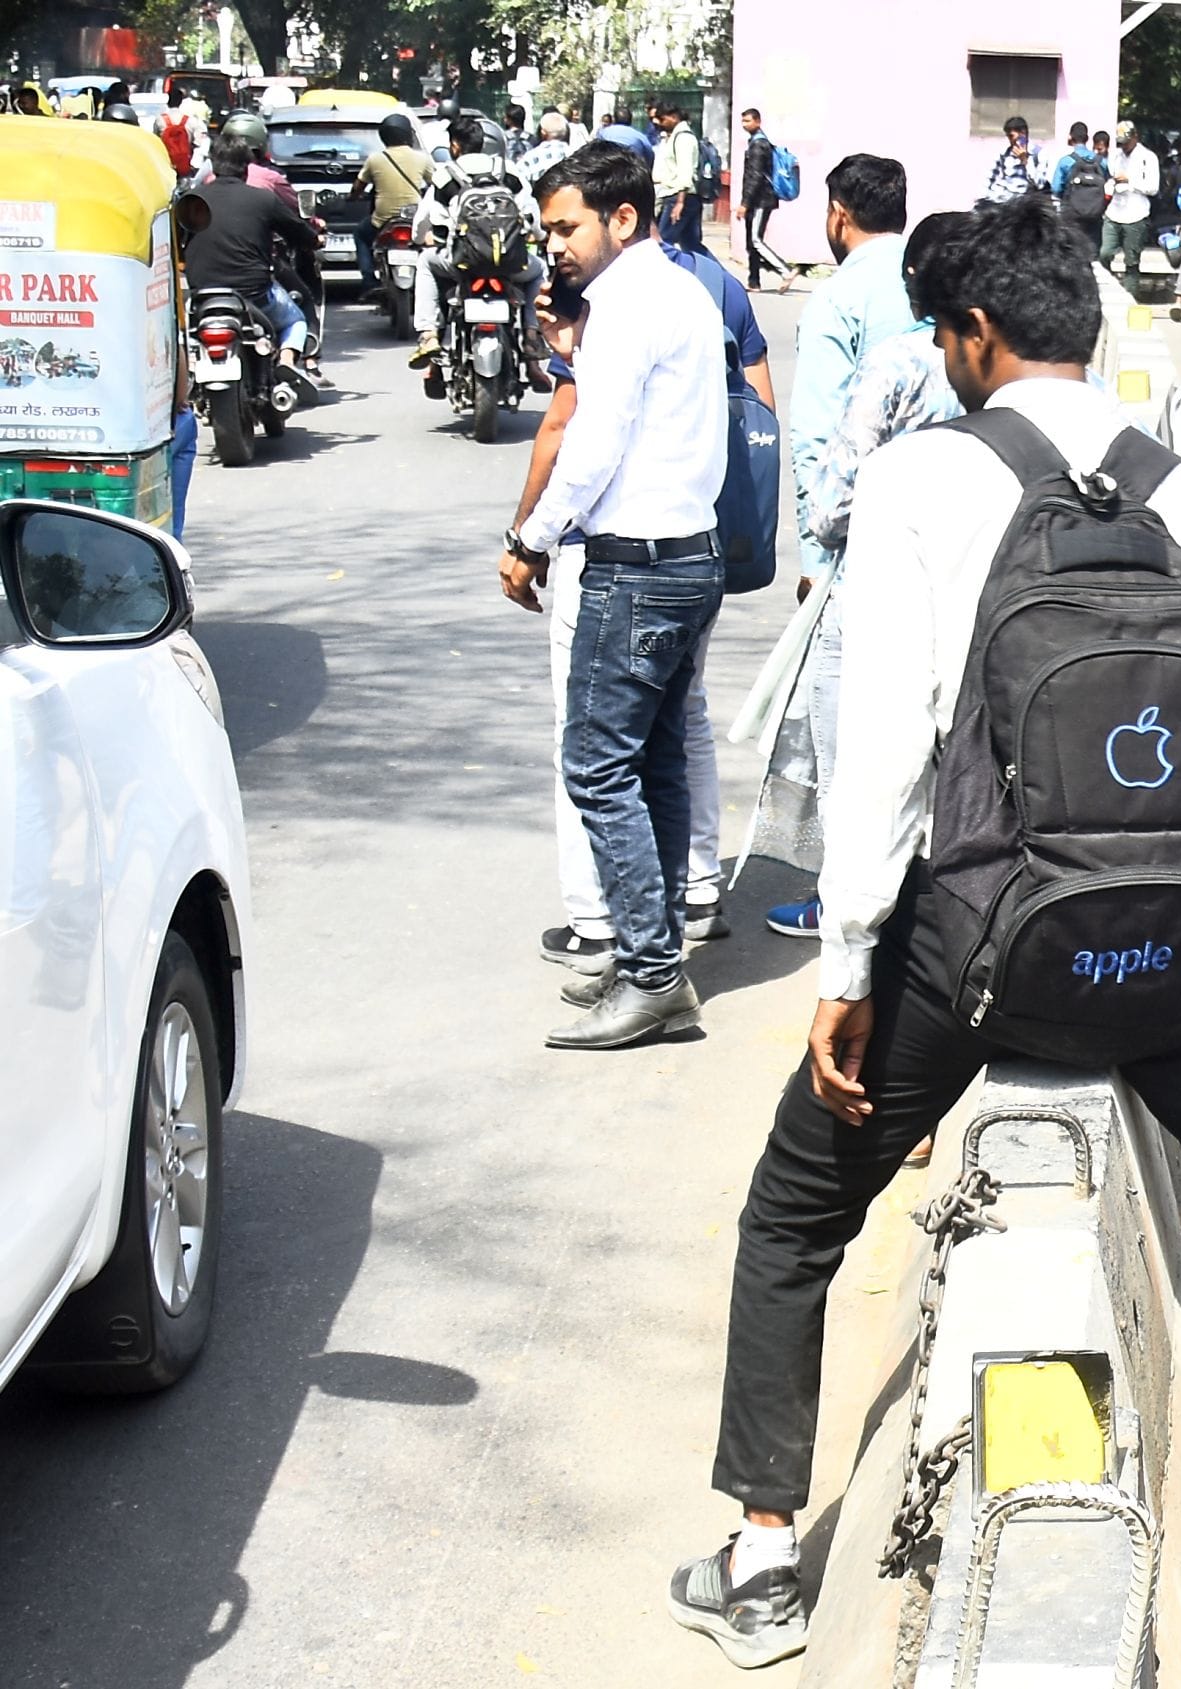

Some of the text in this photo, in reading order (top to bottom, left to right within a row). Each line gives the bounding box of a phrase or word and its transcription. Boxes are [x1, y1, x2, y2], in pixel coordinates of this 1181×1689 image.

[21, 273, 98, 302] PARK
[10, 311, 81, 325] BANQUET HALL
[51, 406, 101, 417] लखनऊ
[1071, 941, 1174, 985] apple
